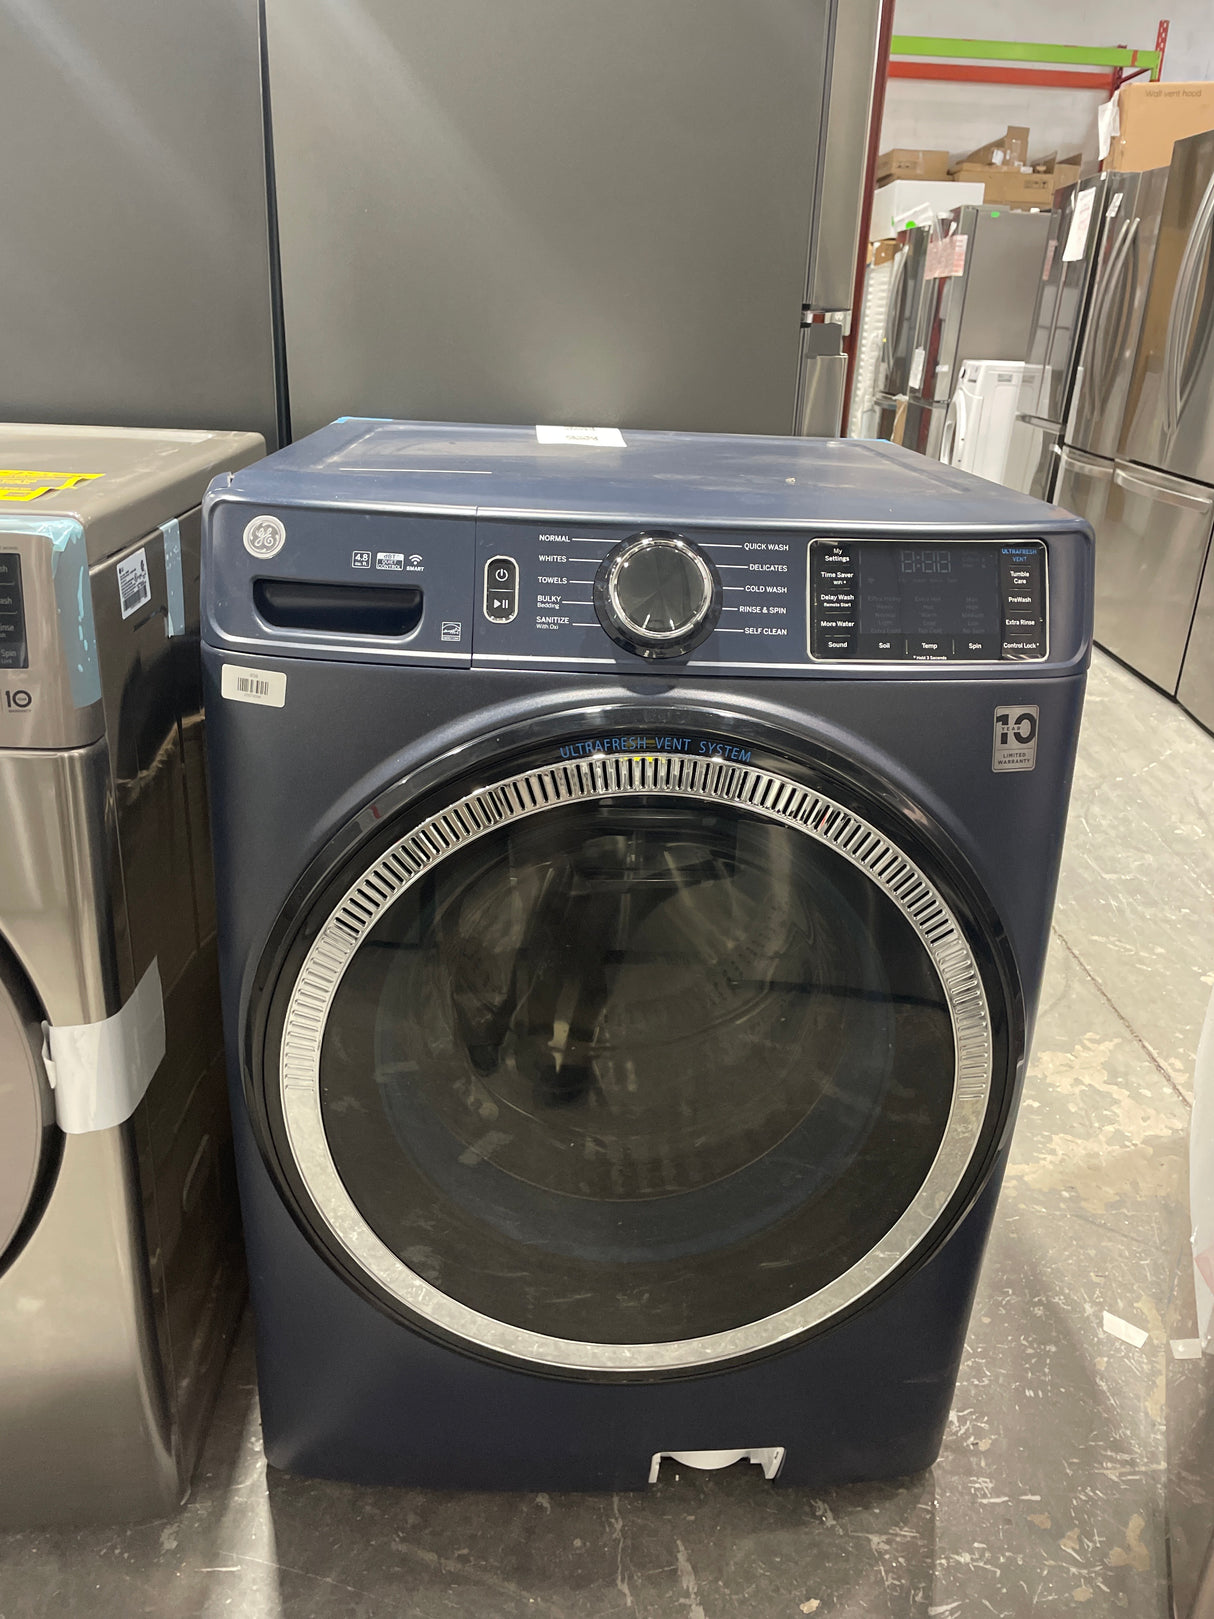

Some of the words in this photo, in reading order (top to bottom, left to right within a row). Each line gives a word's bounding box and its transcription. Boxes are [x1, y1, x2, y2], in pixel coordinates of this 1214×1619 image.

[1145, 89, 1162, 97] Wall
[1182, 89, 1202, 97] hood
[538, 576, 567, 584] TOWELS
[1, 648, 17, 659] Spin
[5, 690, 32, 708] 10
[996, 713, 1037, 744] 10
[559, 736, 647, 758] ULTRAFRESH
[655, 736, 692, 751] VENT
[698, 740, 752, 763] SYSTEM
